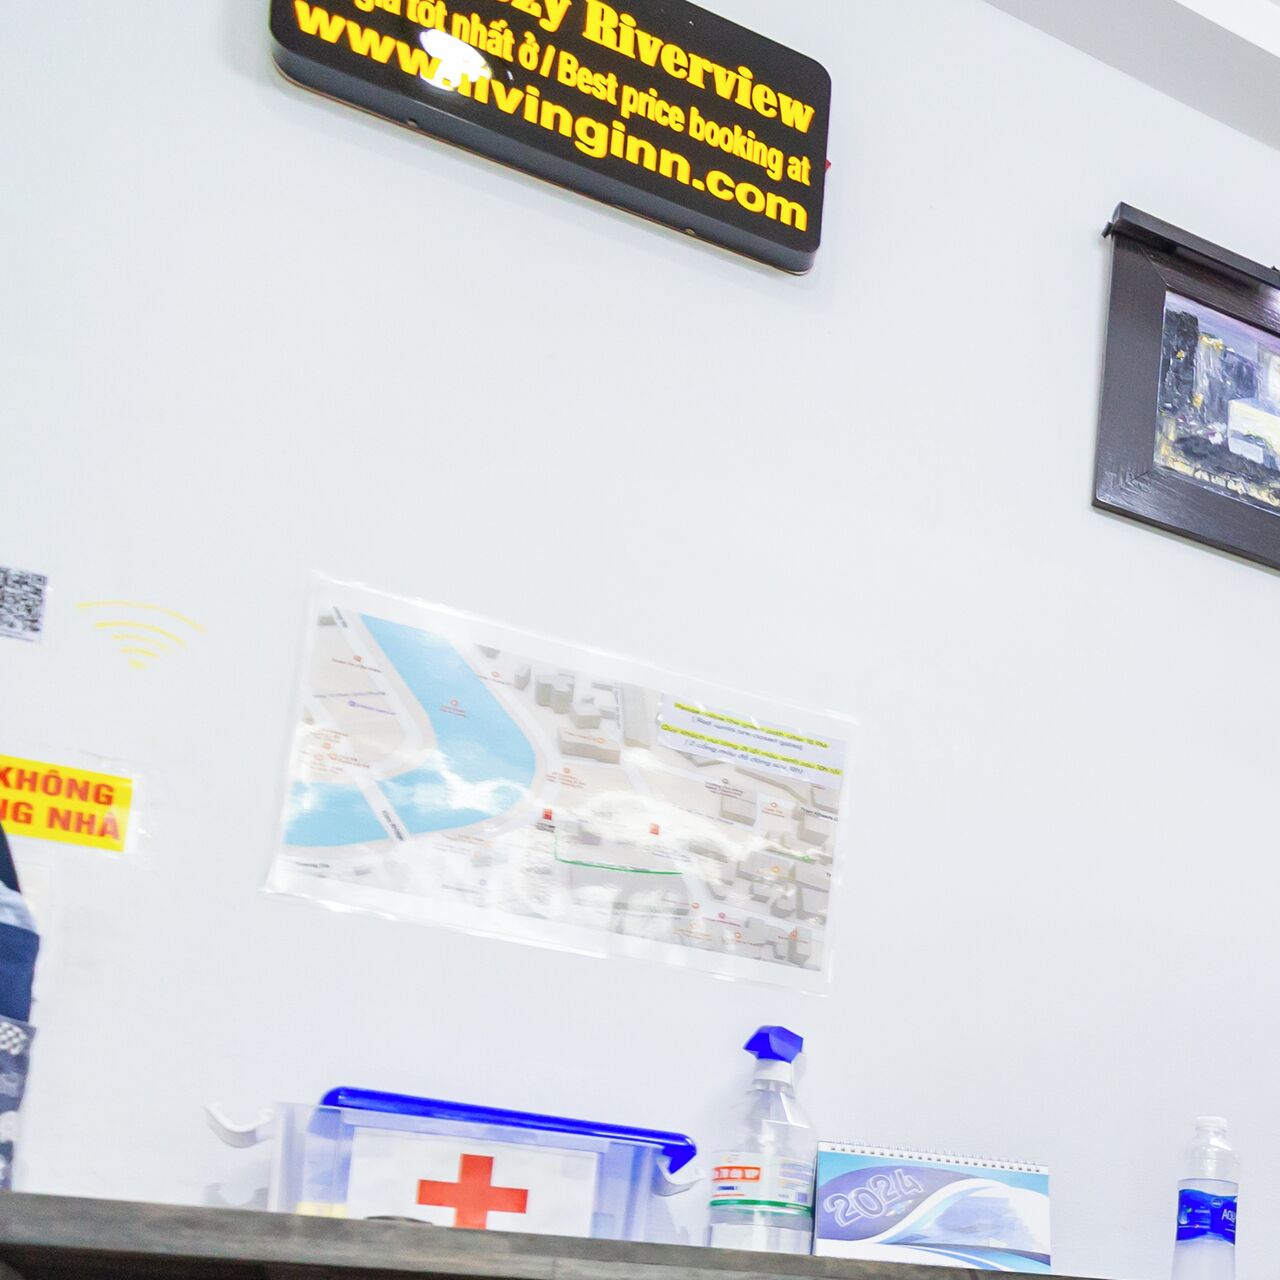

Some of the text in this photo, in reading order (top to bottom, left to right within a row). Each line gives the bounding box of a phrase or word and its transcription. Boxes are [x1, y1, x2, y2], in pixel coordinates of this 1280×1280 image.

[451, 12, 515, 63] nhất
[518, 31, 541, 71] ở
[557, 50, 619, 105] Best
[620, 84, 686, 133] price
[688, 106, 784, 182] booking
[787, 155, 811, 187] at
[582, 0, 816, 134] Riverview
[0, 765, 114, 806] KHÔNG
[824, 1168, 924, 1229] 2024
